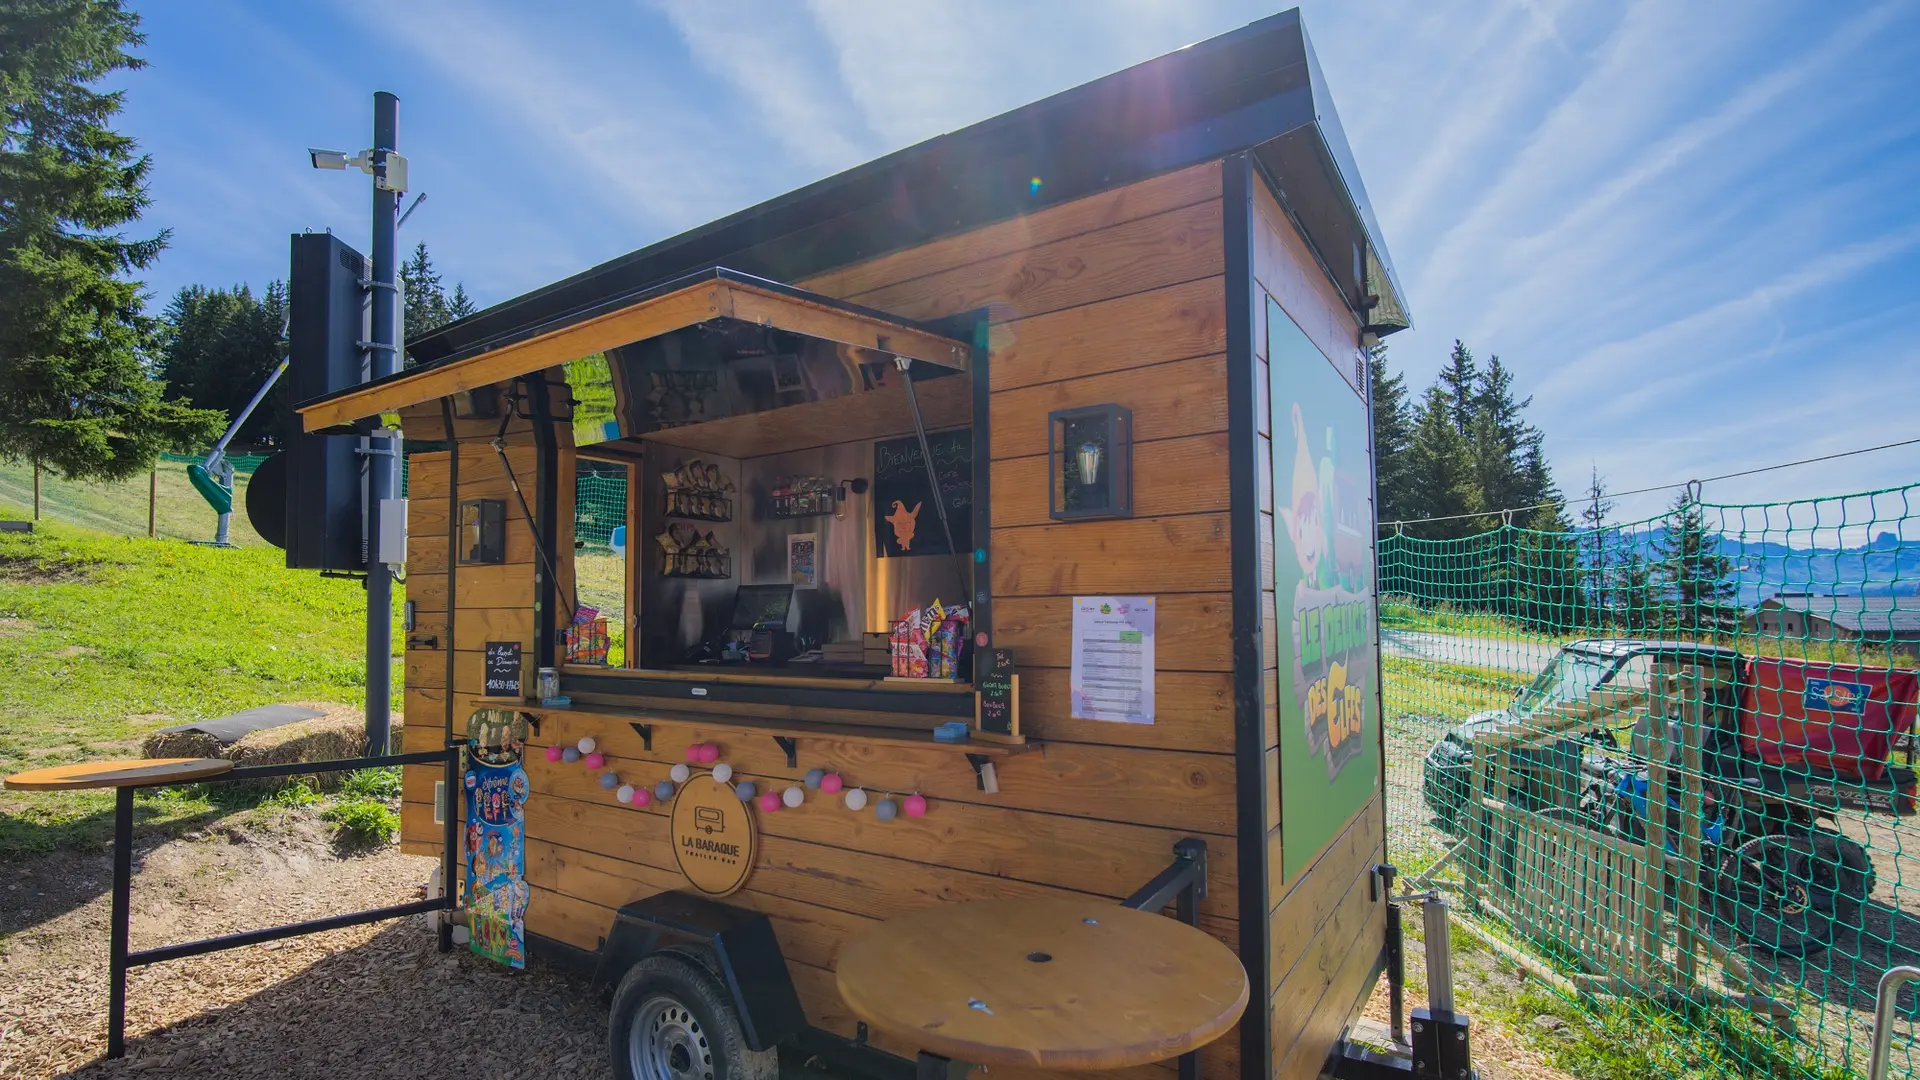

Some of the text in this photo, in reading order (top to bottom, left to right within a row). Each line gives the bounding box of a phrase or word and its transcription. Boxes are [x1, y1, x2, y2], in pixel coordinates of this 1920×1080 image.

[1300, 604, 1322, 666] LE
[1308, 649, 1362, 748] DES ELFES
[681, 835, 740, 857] LA BARAQUE
